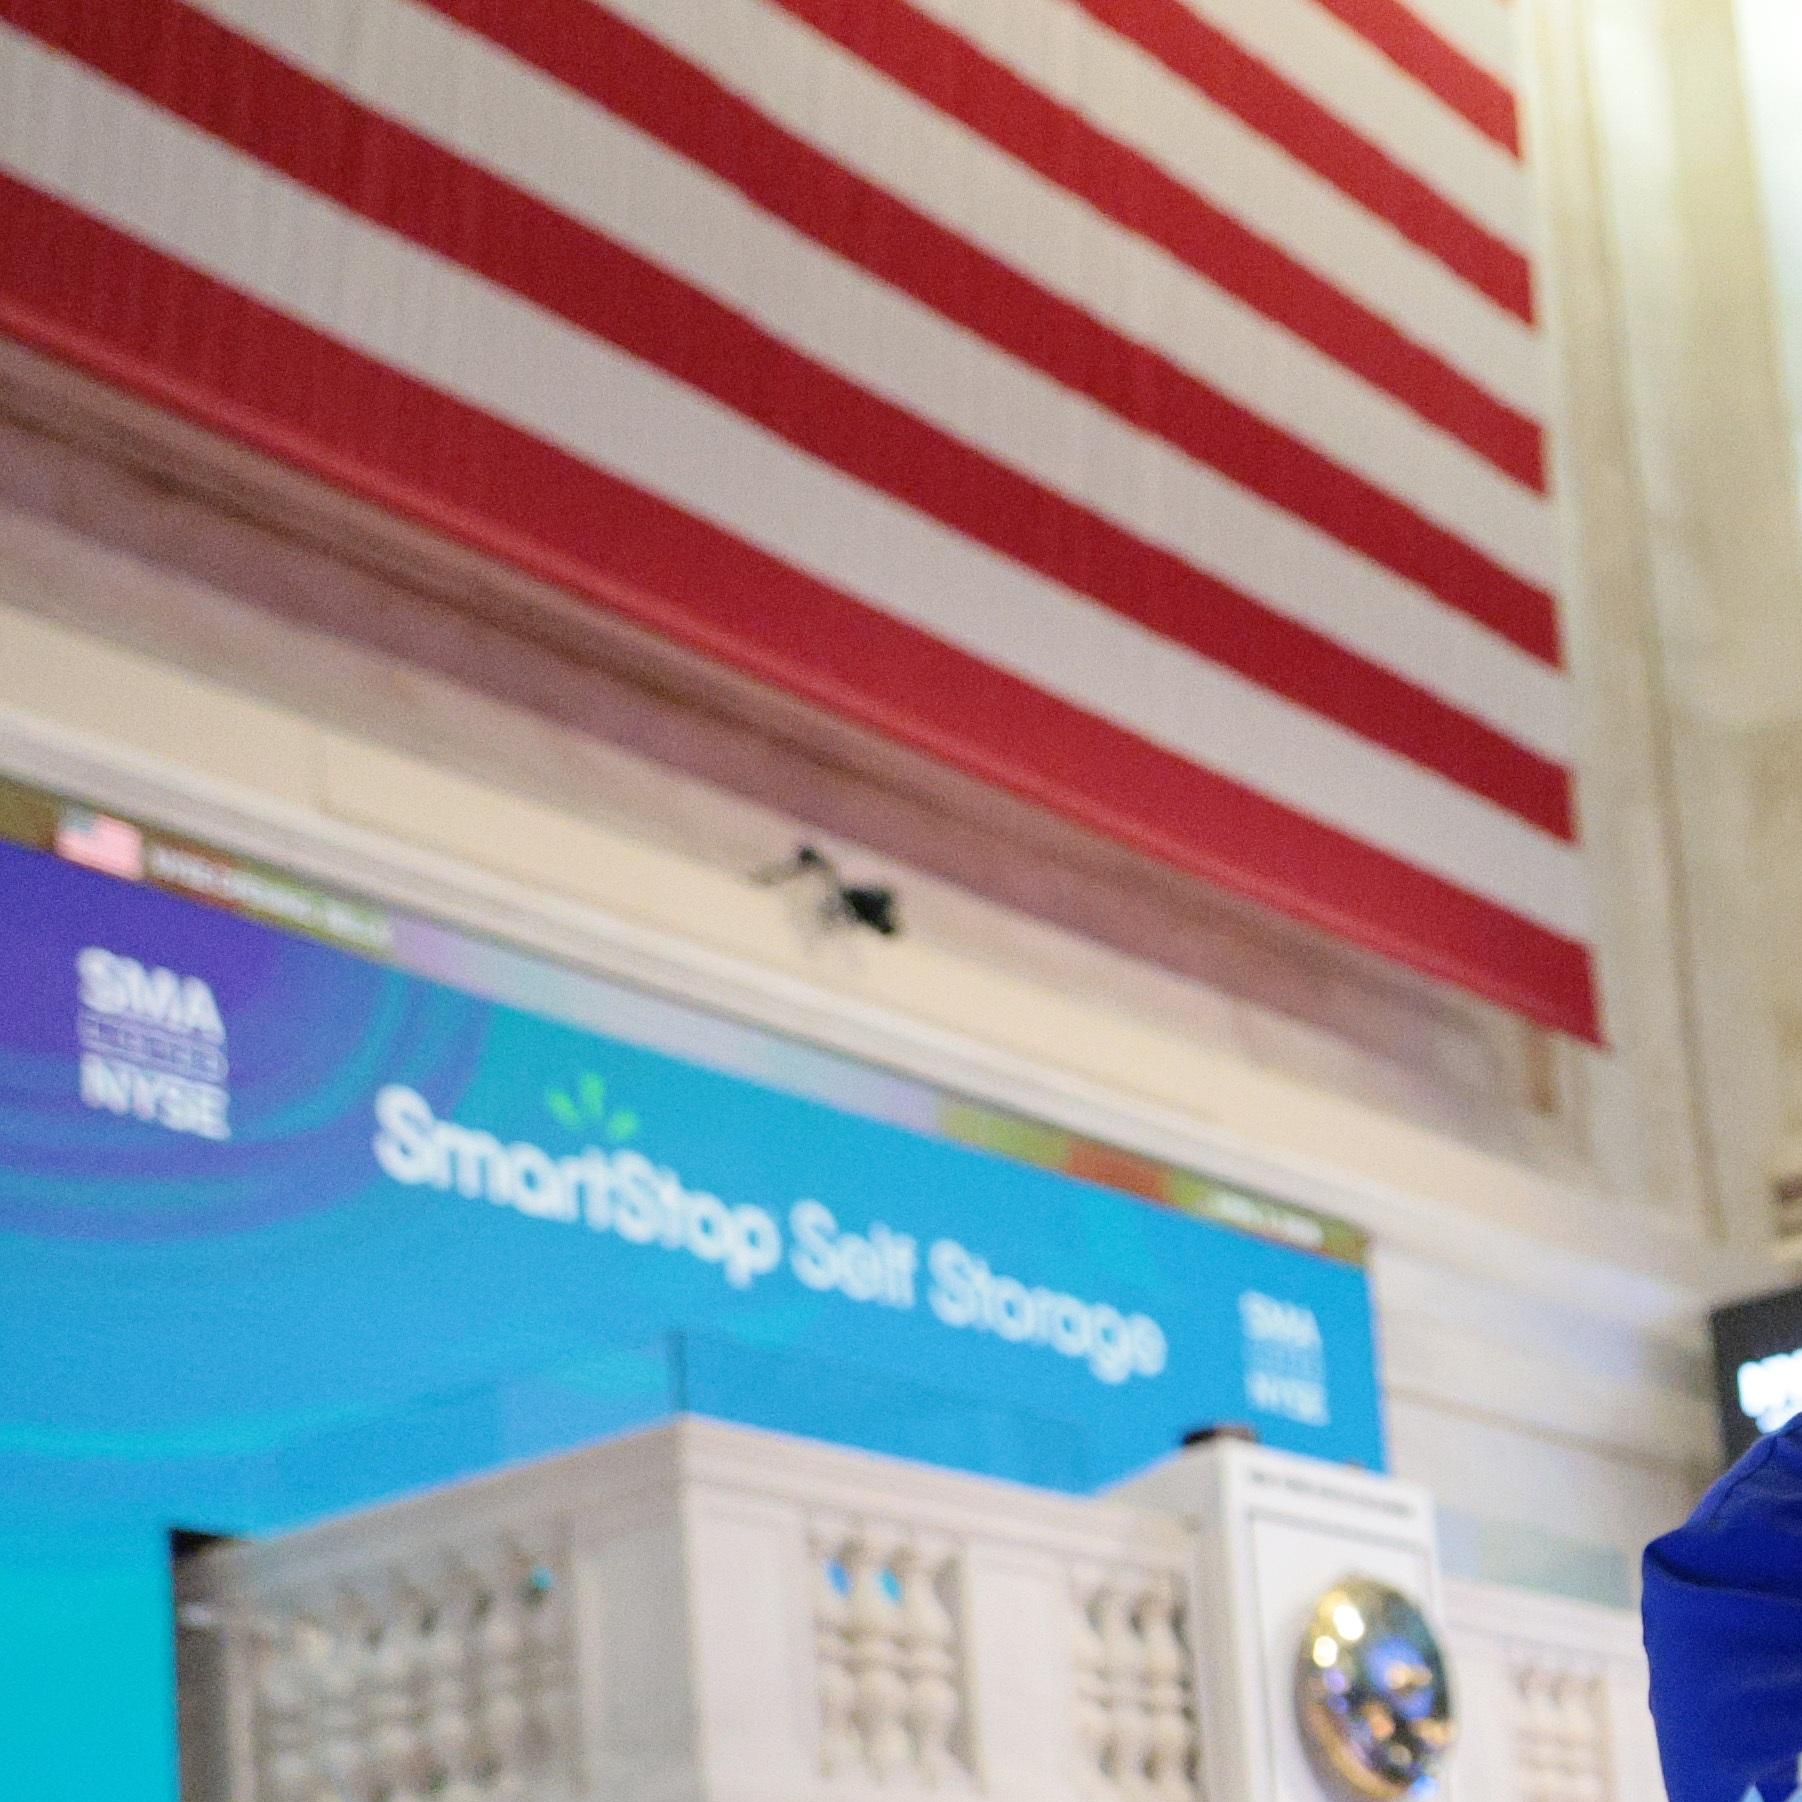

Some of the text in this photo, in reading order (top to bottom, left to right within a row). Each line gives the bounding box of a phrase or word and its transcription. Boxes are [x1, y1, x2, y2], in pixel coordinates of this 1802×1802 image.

[77, 945, 226, 1047] SMA
[80, 1052, 231, 1141] NYSE
[373, 1084, 1167, 1384] SmartStop Self Storage
